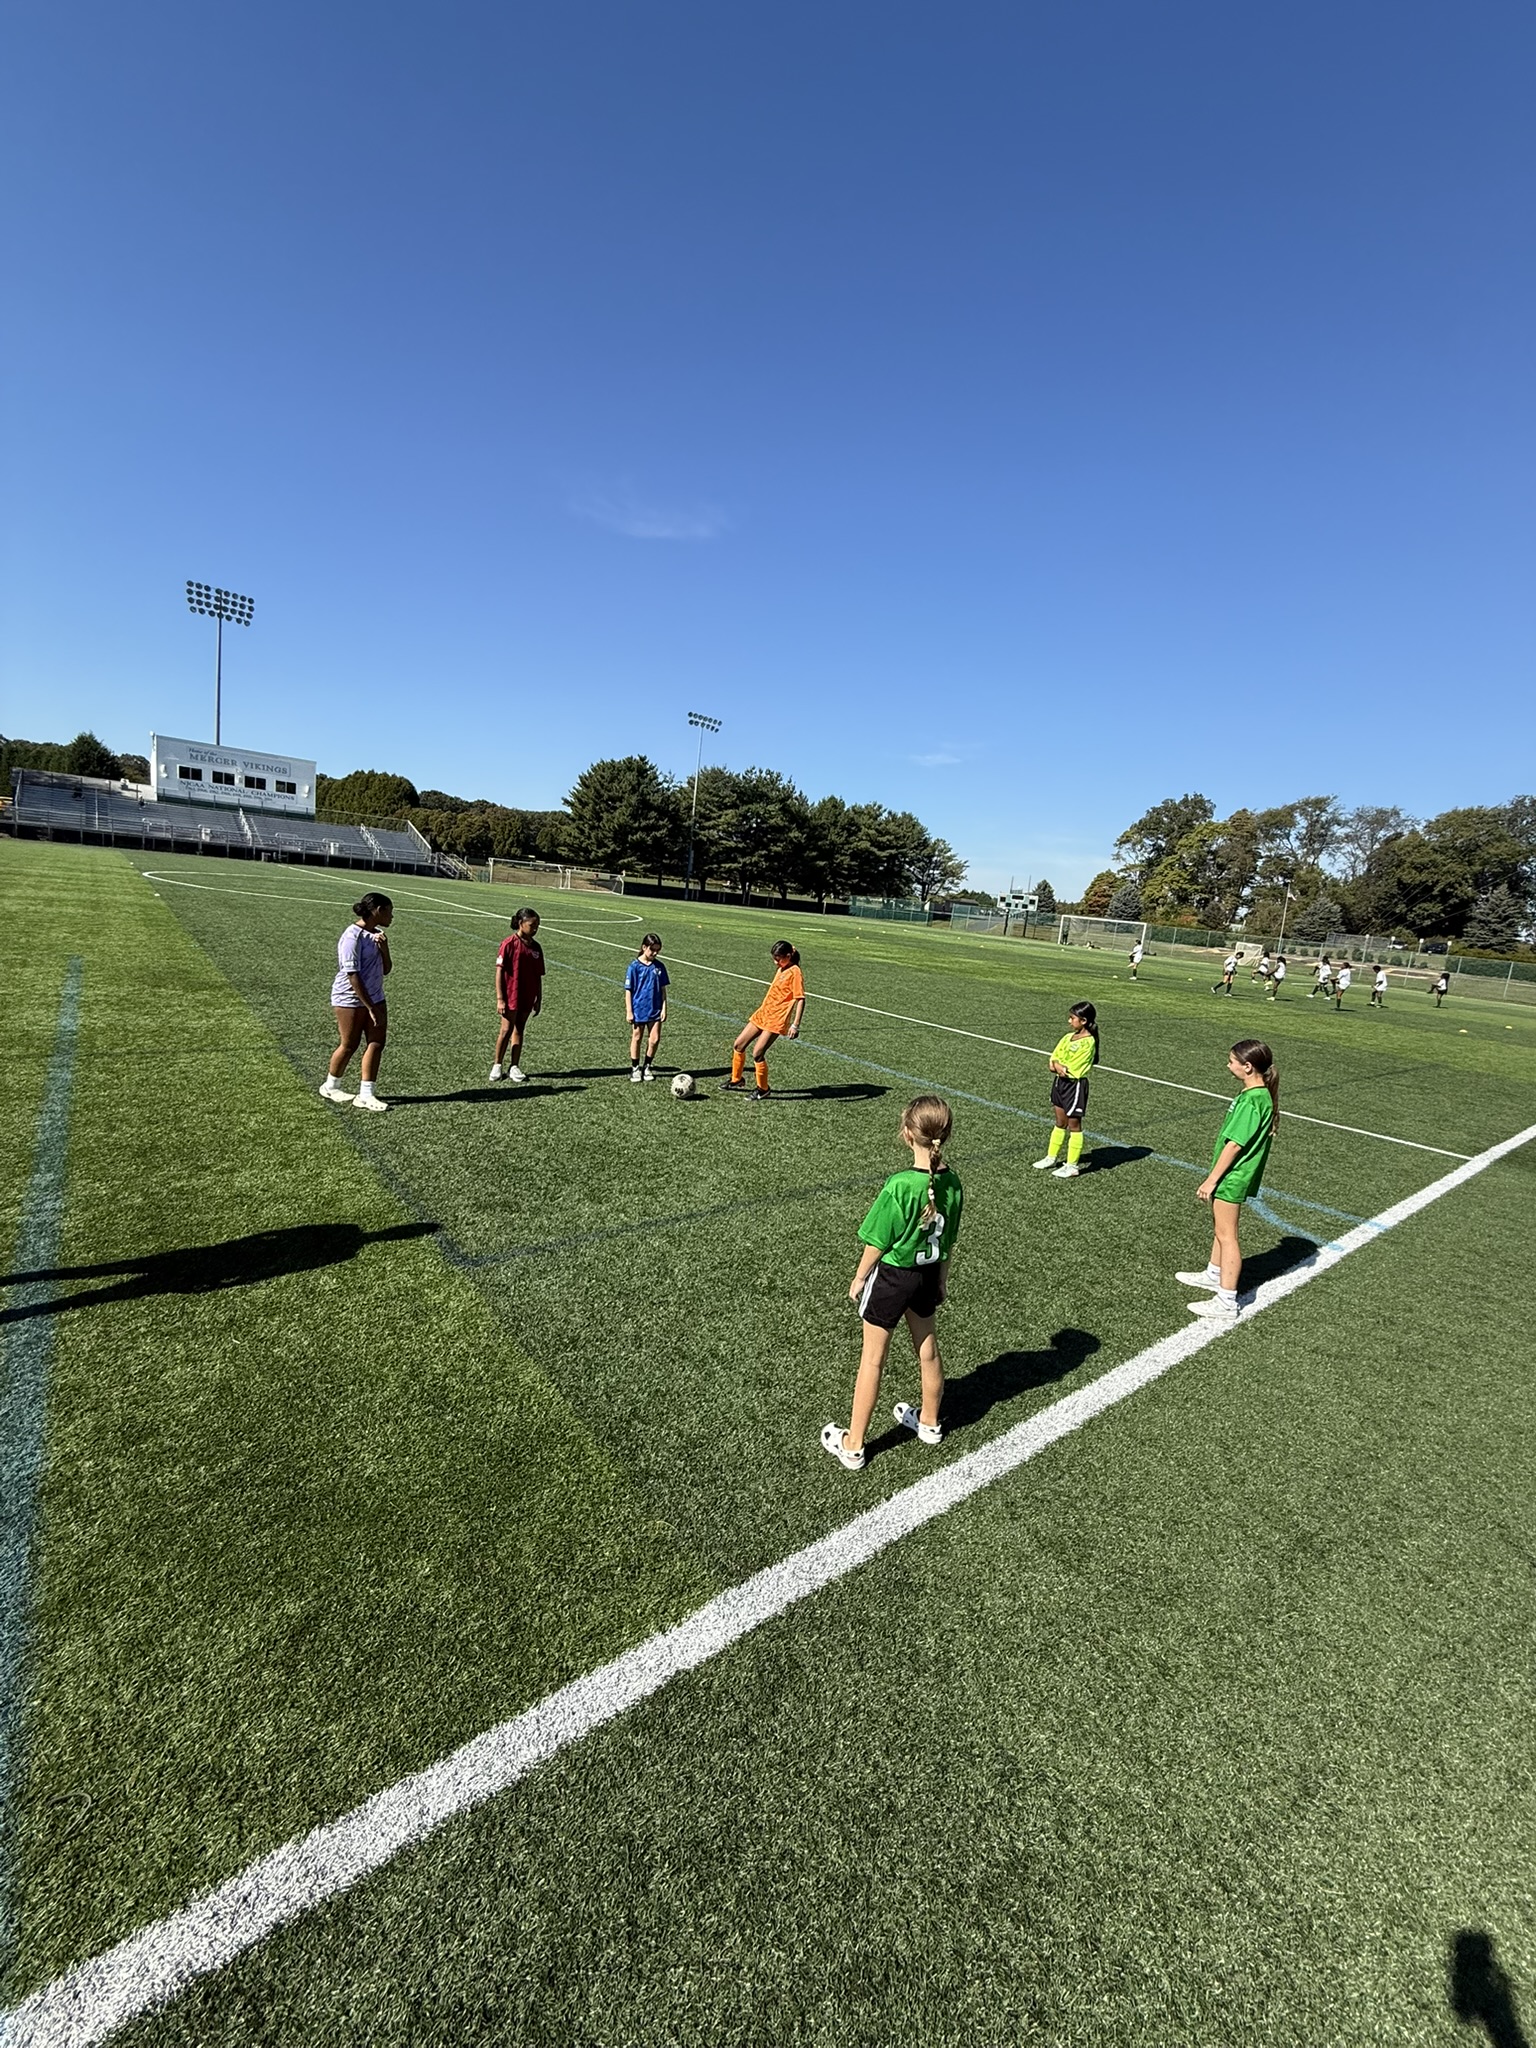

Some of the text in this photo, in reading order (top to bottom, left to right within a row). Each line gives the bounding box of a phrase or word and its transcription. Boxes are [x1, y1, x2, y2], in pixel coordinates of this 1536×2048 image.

[189, 753, 288, 775] MERCER VIKINGS
[180, 780, 205, 789] NJCAA
[208, 784, 246, 794] NATIONAL
[251, 790, 295, 801] CHAMPIONS
[916, 1213, 945, 1266] 3
